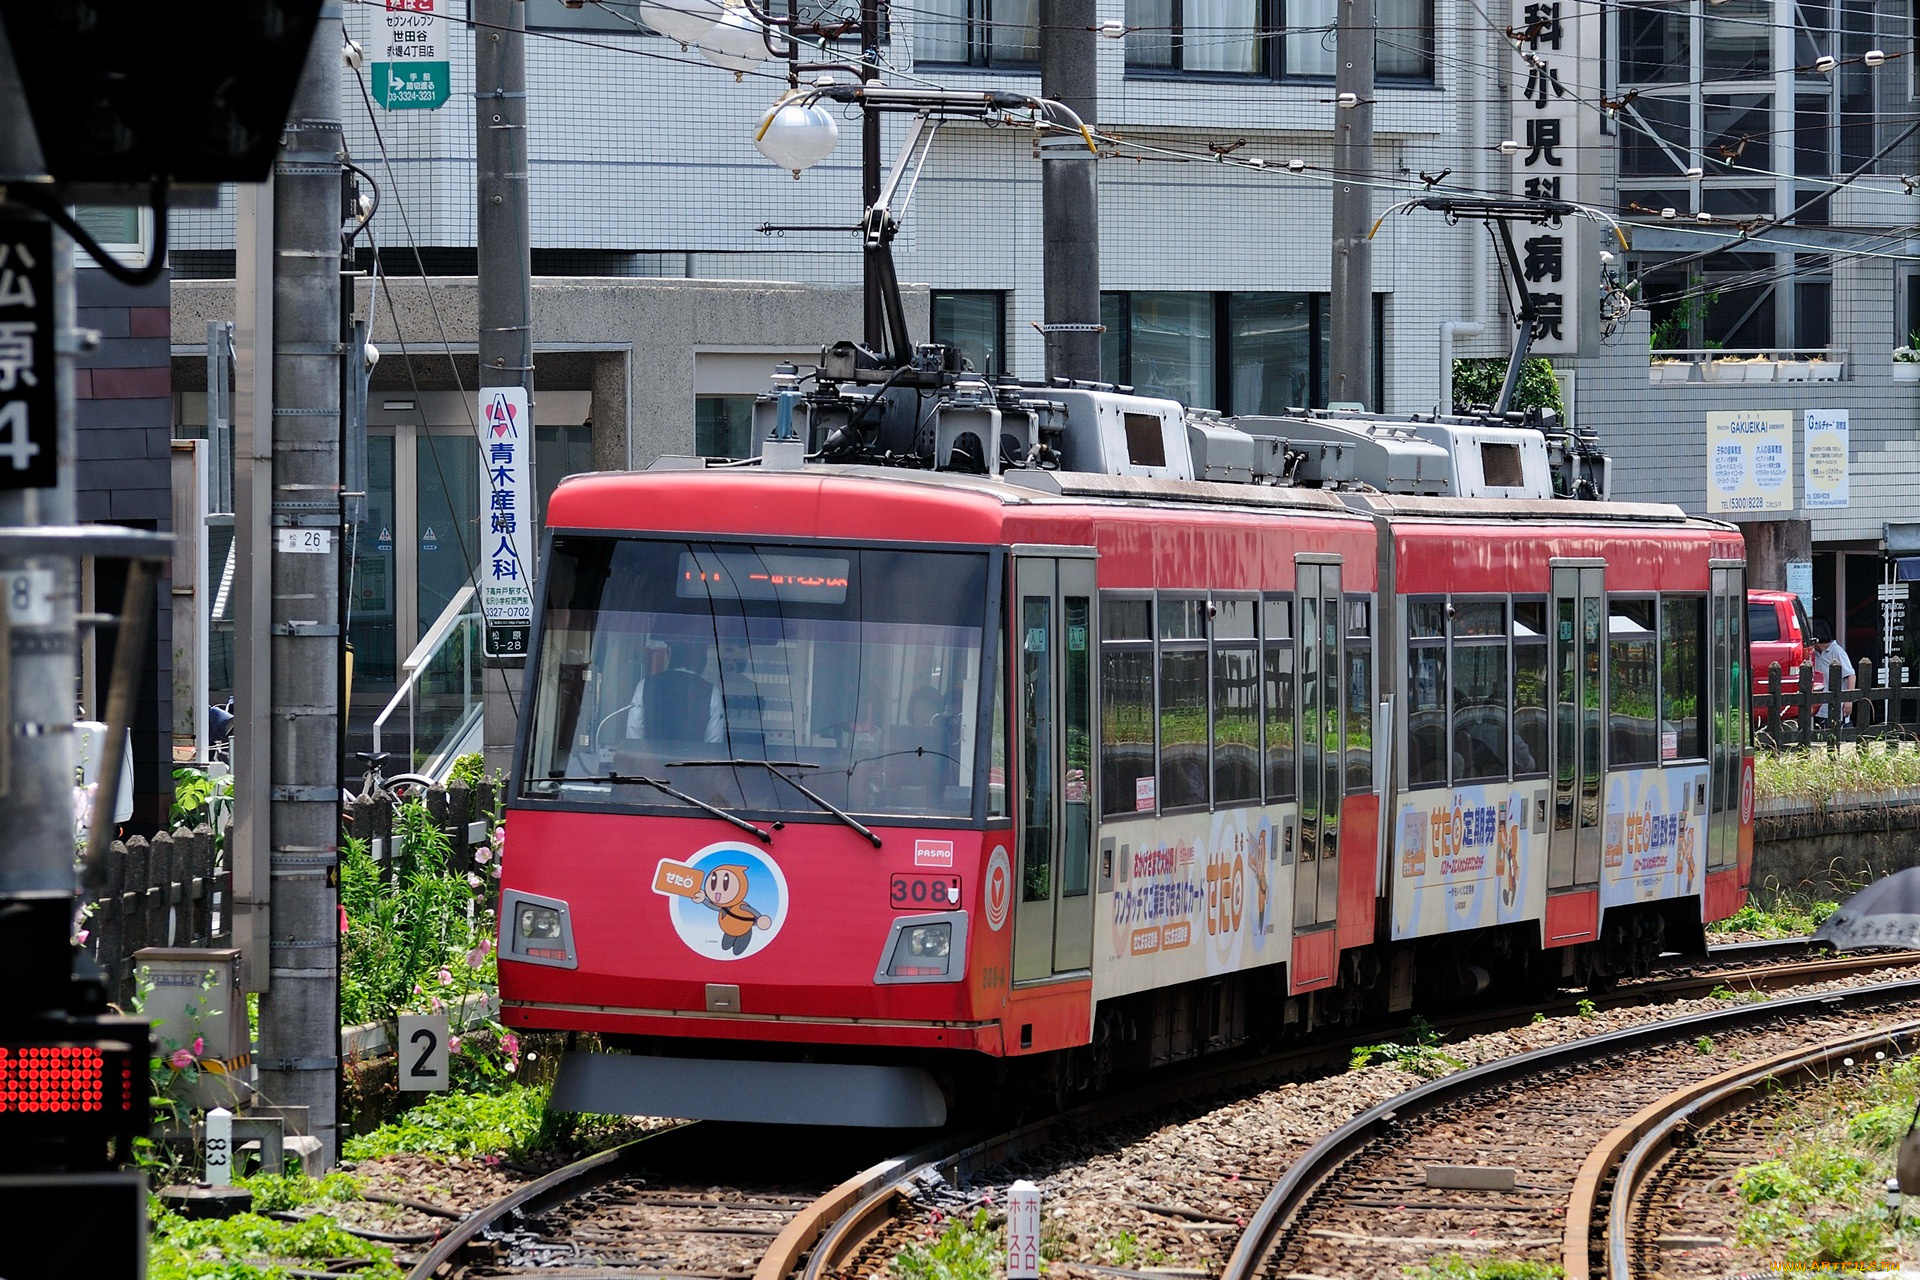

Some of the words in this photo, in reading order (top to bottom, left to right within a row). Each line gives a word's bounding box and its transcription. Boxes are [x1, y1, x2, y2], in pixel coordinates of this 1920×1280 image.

[394, 30, 427, 42] 世田谷
[387, 45, 434, 58] 赤堤4丁目店
[388, 90, 436, 101] 03-3324-3231
[1730, 421, 1768, 434] GAKUEIKAI
[489, 442, 518, 581] 青木産婦人科
[304, 532, 321, 547] 26
[12, 575, 30, 611] 8
[485, 607, 530, 617] 3327-0702
[493, 641, 522, 651] 3-28
[917, 849, 951, 858] PASMO
[892, 880, 947, 903] 308
[410, 1028, 437, 1077] 2
